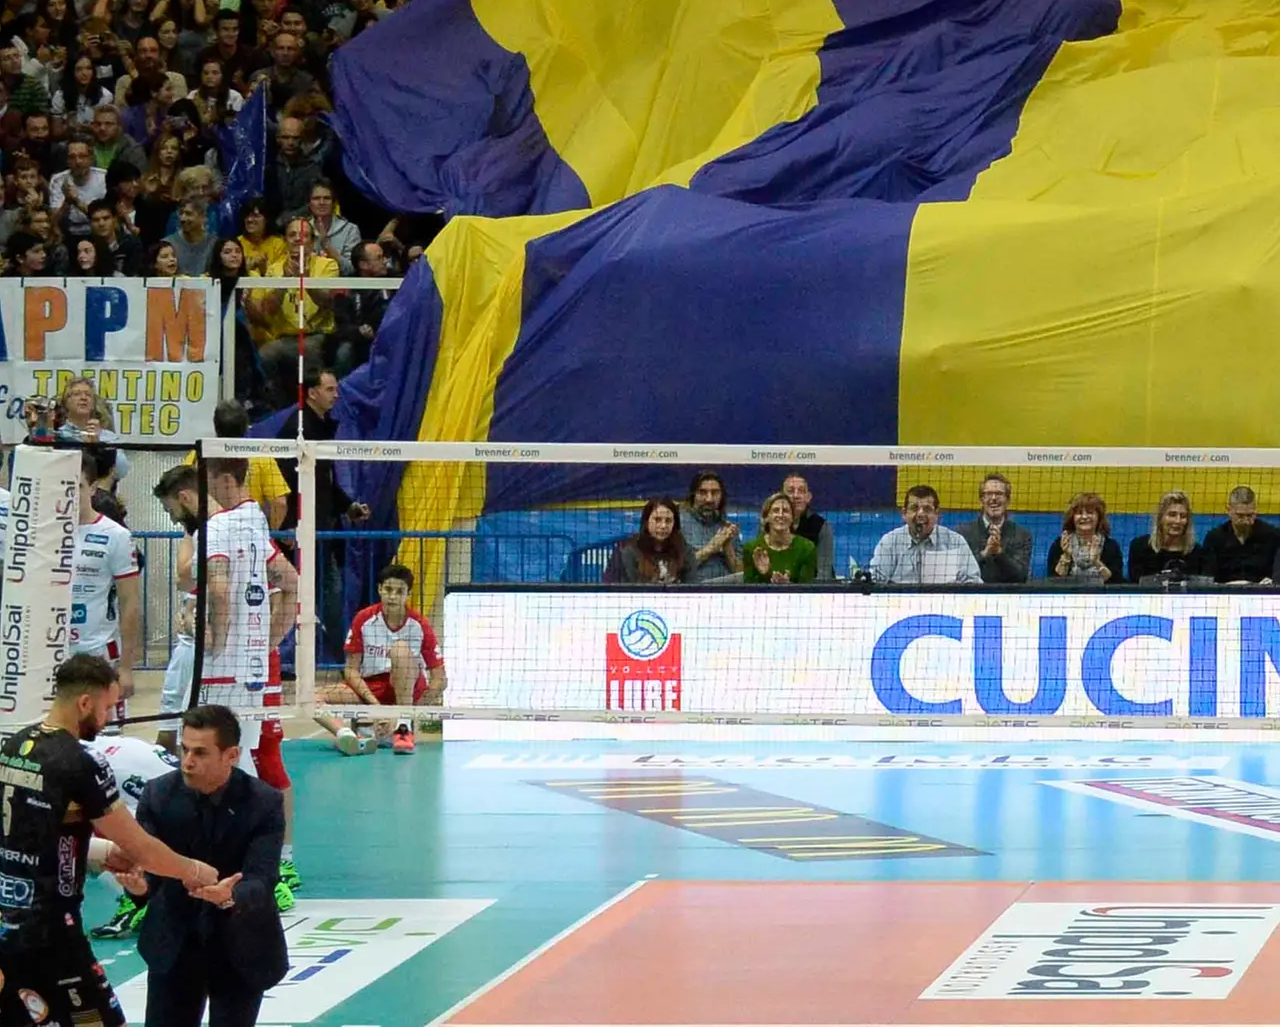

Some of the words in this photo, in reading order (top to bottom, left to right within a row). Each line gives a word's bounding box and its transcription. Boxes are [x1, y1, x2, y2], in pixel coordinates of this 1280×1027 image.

[33, 370, 204, 402] TRNTINO
[7, 476, 33, 583] UnipolSai
[52, 480, 76, 585] UnipolSai
